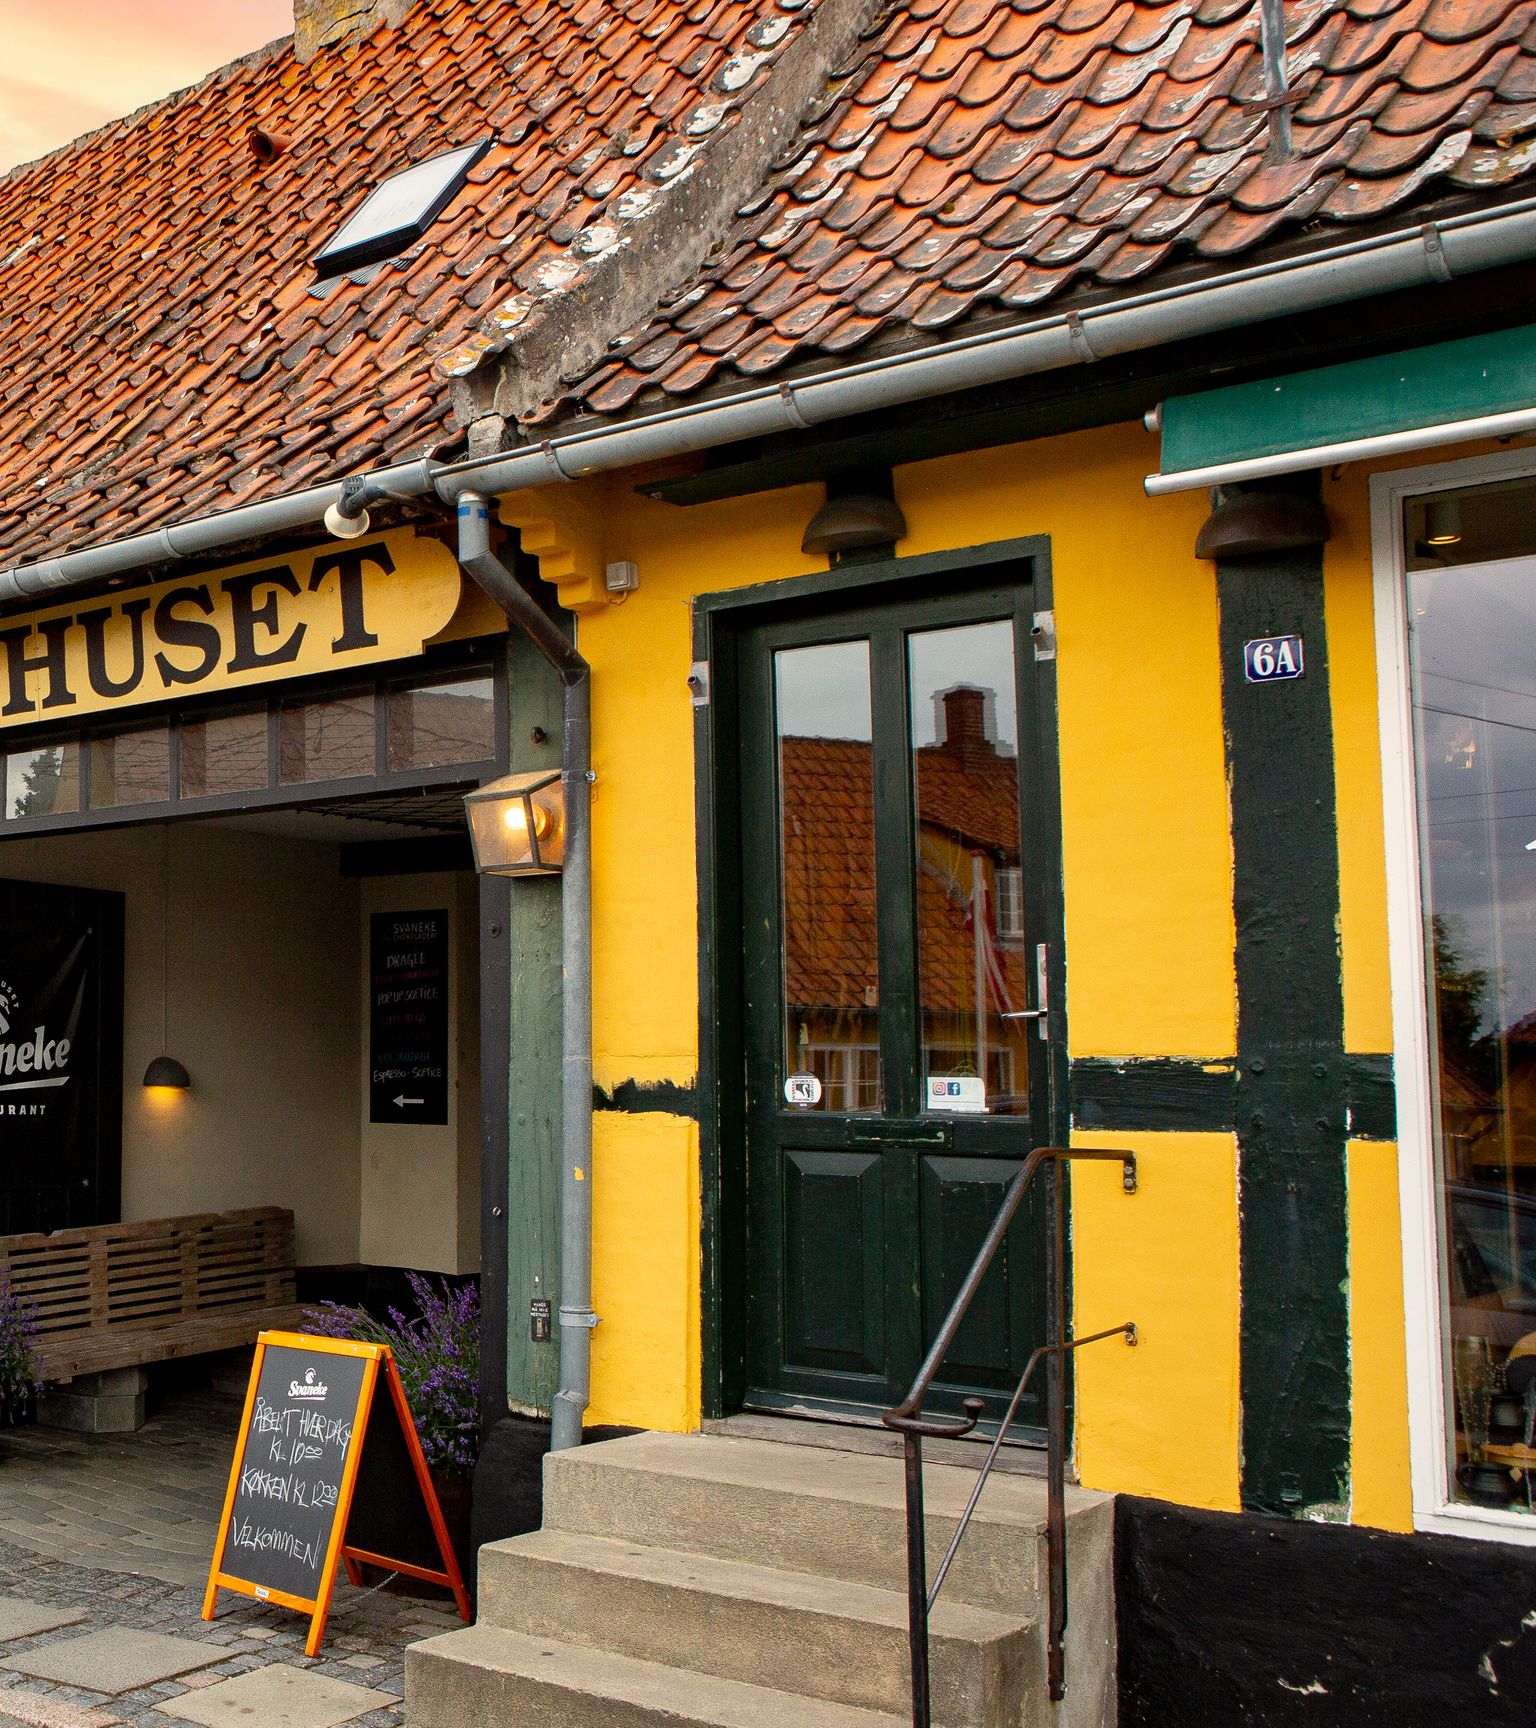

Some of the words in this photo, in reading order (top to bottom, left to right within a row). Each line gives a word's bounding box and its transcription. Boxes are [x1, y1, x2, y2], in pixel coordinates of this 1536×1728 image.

[1253, 640, 1297, 676] 6A
[393, 921, 436, 934] SVANEKE
[287, 1380, 328, 1397] Svaneke
[299, 1408, 327, 1442] HVER
[233, 1515, 322, 1570] VELKOMMEN
